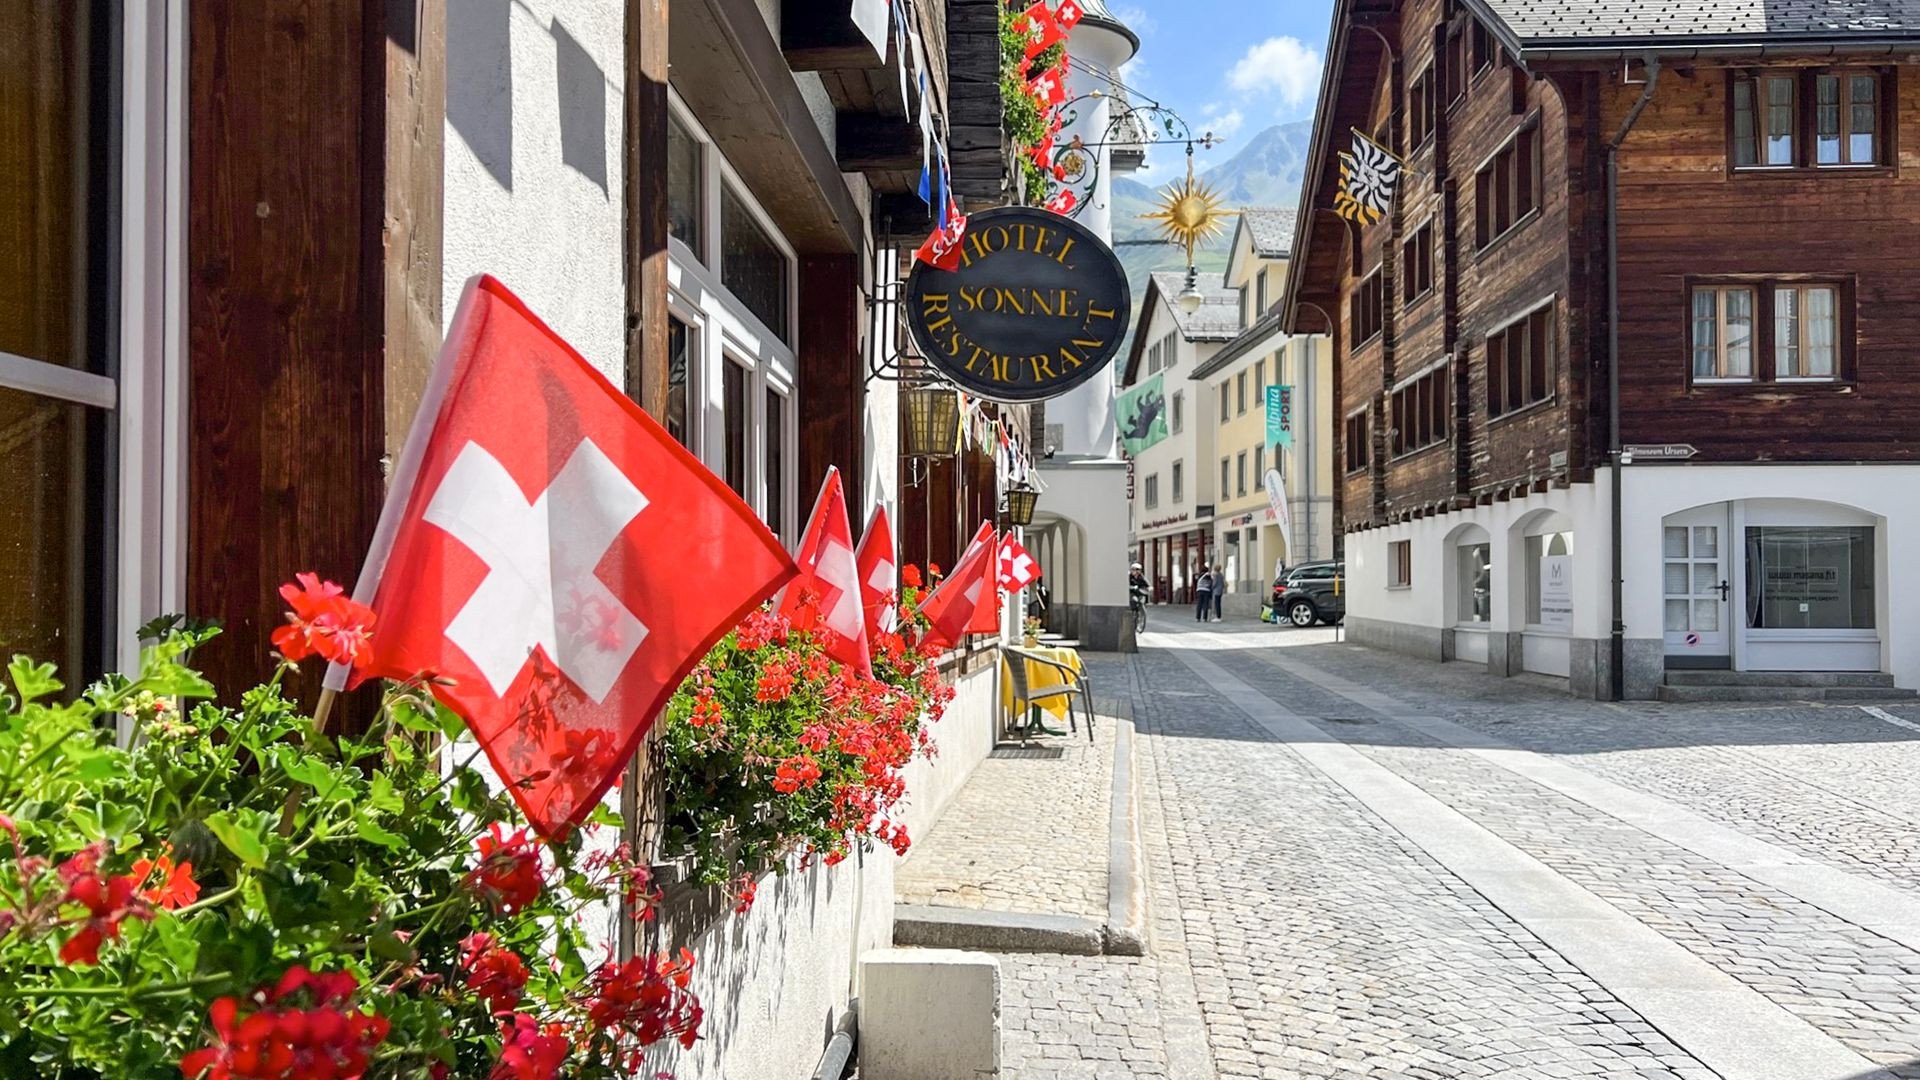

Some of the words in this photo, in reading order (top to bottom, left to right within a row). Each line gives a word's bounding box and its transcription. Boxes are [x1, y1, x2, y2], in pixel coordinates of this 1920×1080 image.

[961, 223, 1076, 268] HOTEL
[958, 285, 1080, 317] SONNE
[922, 293, 1116, 383] RESTAURANT
[1268, 388, 1281, 436] Alpina
[1280, 390, 1290, 431] SPORT
